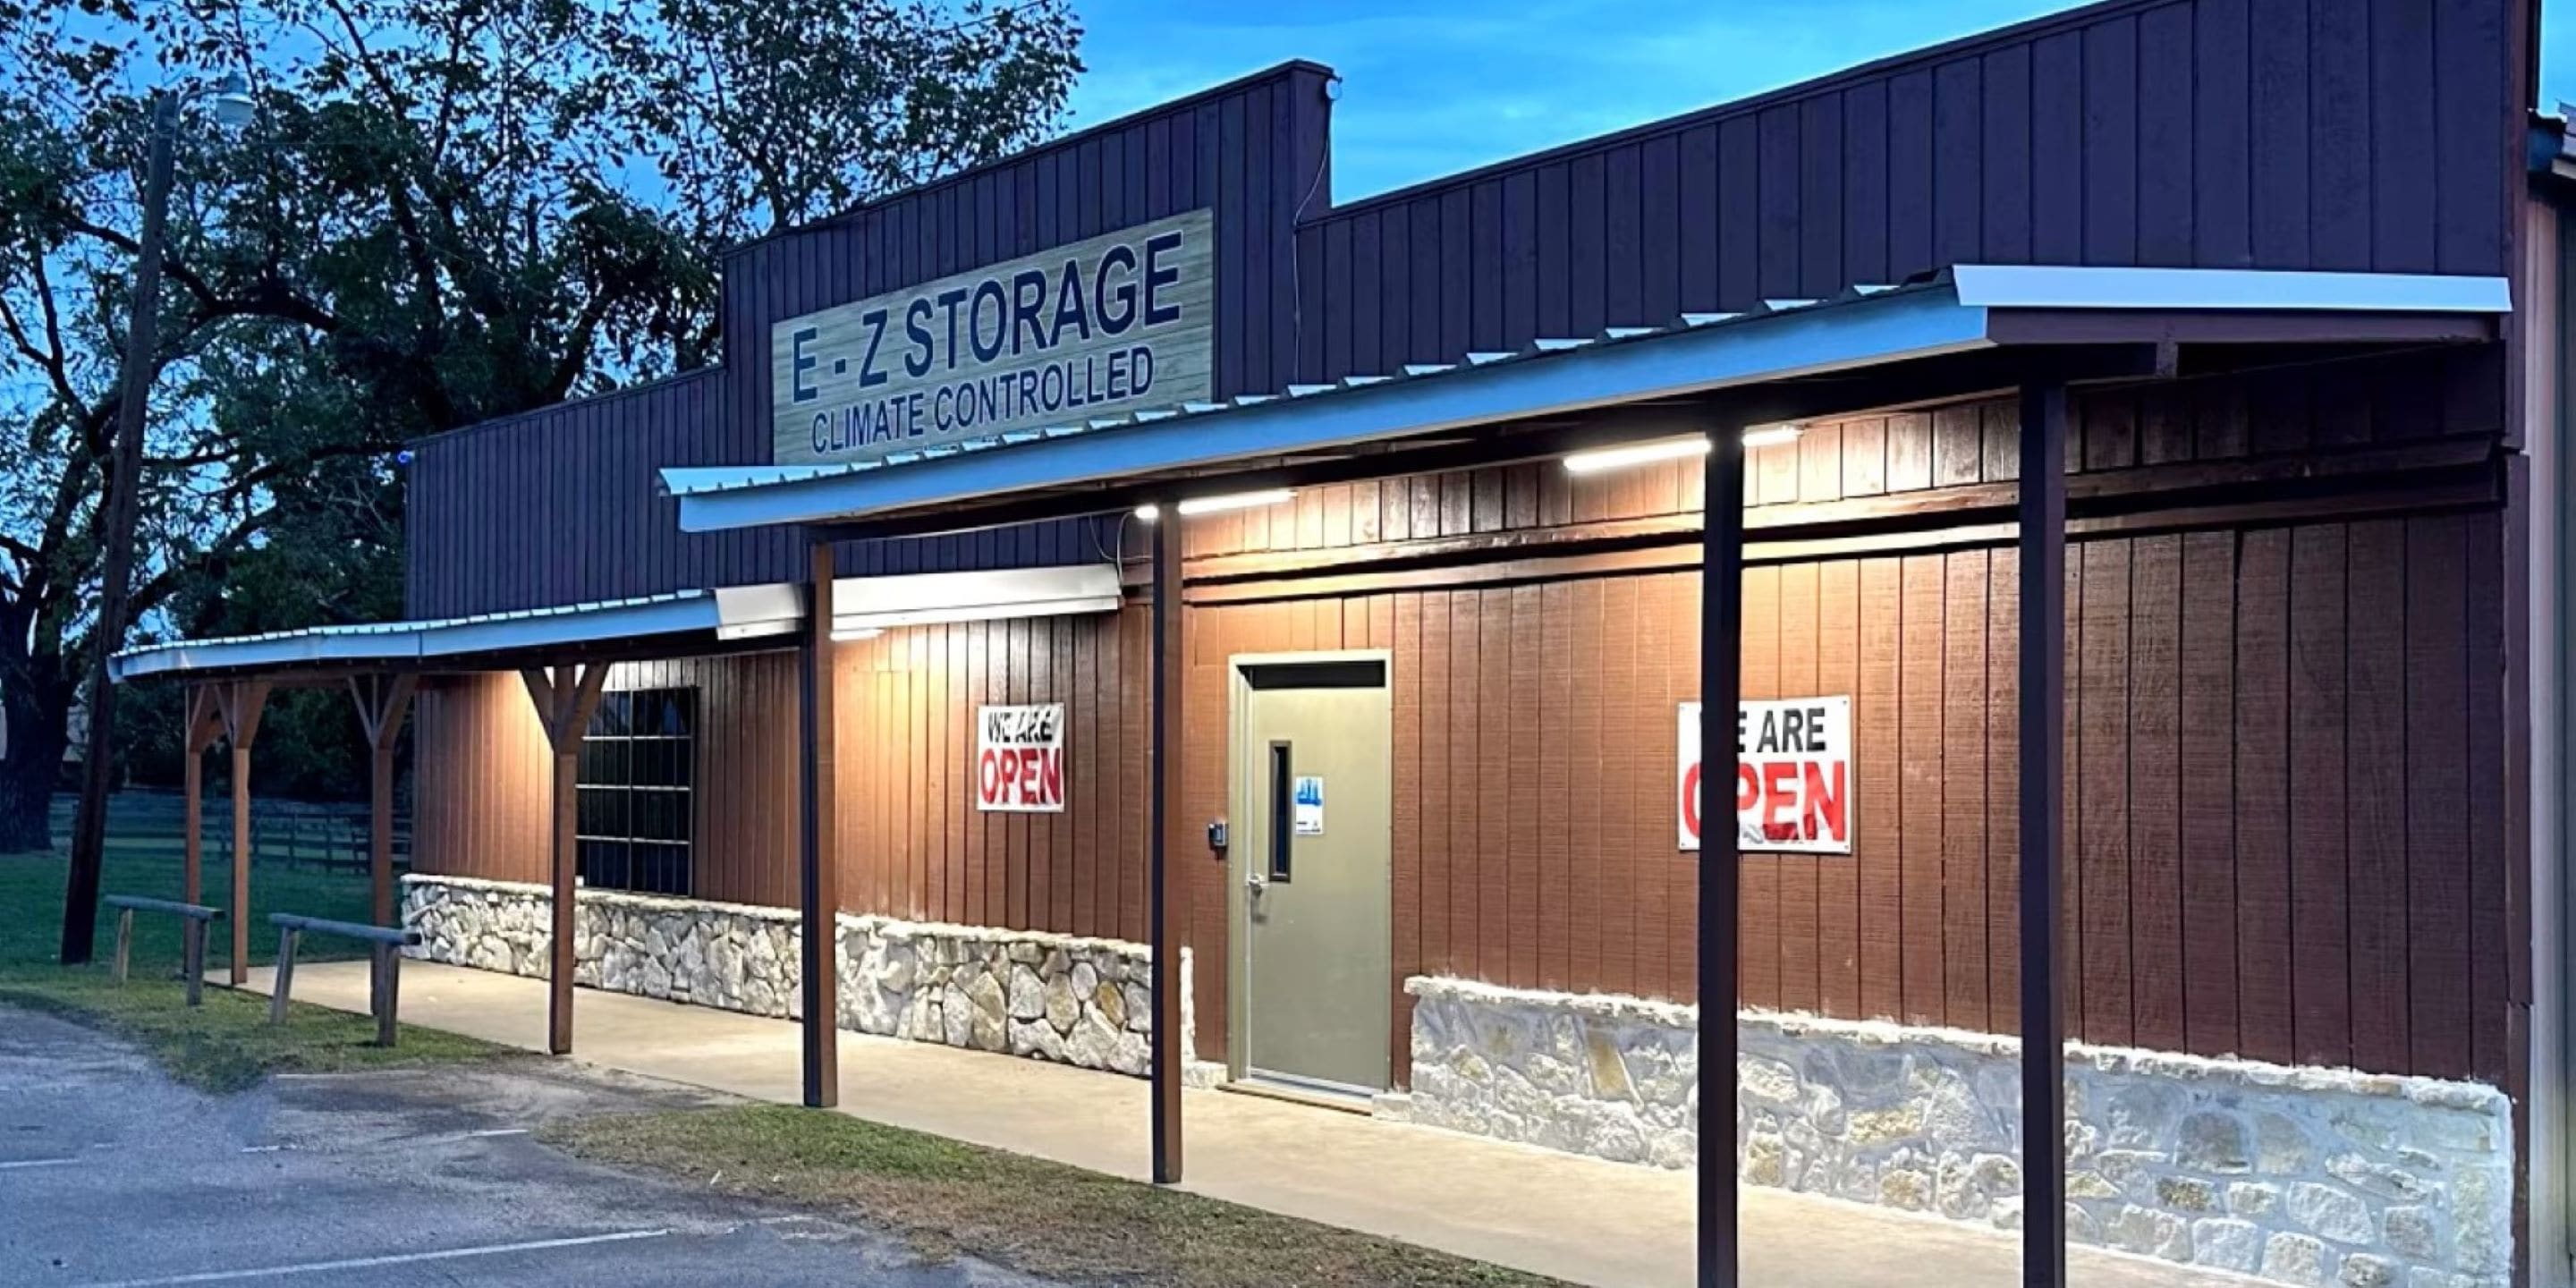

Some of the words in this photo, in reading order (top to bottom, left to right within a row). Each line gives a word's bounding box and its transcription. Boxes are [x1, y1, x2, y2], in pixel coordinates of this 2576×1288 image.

[793, 327, 818, 402] E
[860, 309, 887, 386] Z
[903, 231, 1182, 377] STORAGE
[813, 393, 924, 453] CLIMATE
[935, 345, 1154, 431] CONTROLLED
[988, 712, 1011, 742] WE
[1015, 710, 1053, 742] ARE
[1756, 708, 1826, 753] ARE
[981, 748, 1062, 804] OPEN
